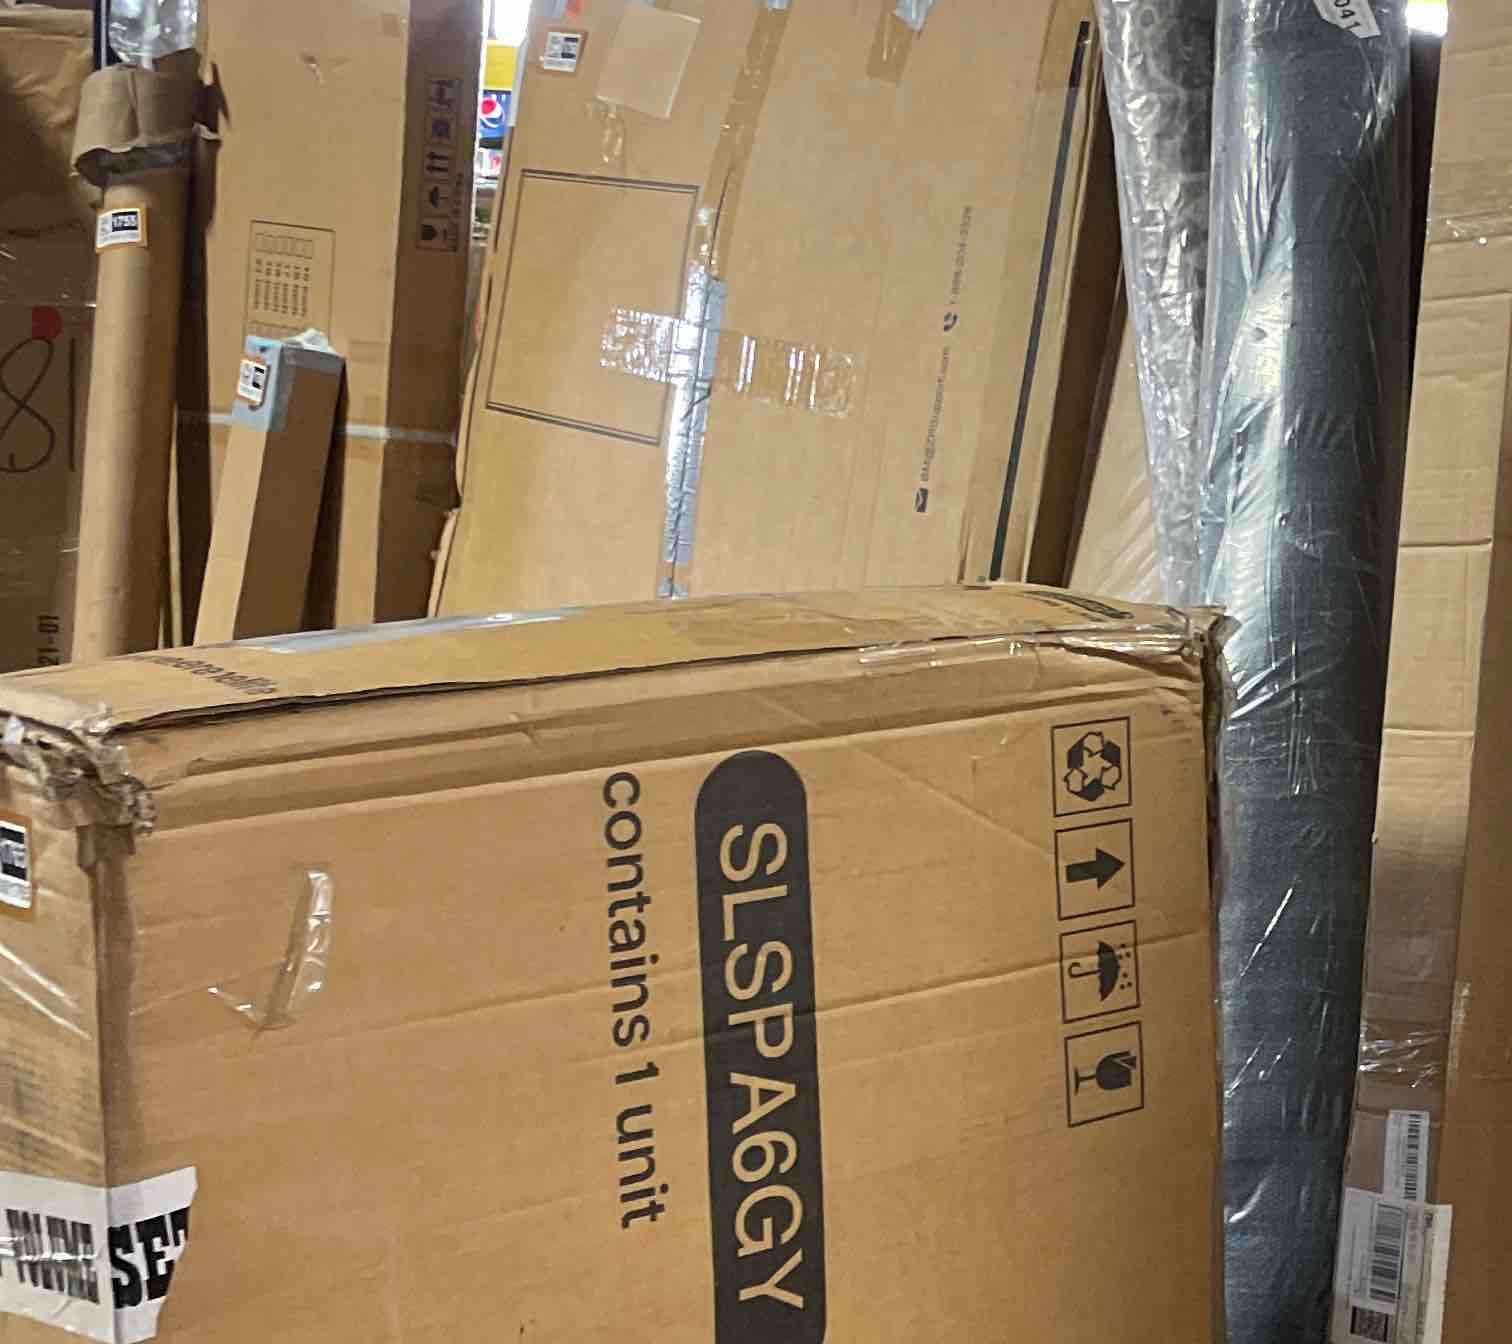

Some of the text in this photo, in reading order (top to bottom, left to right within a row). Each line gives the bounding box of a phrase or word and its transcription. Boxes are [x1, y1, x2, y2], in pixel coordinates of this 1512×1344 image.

[602, 770, 670, 1230] contains 1 unit
[719, 821, 806, 1311] SLSPA6GY
